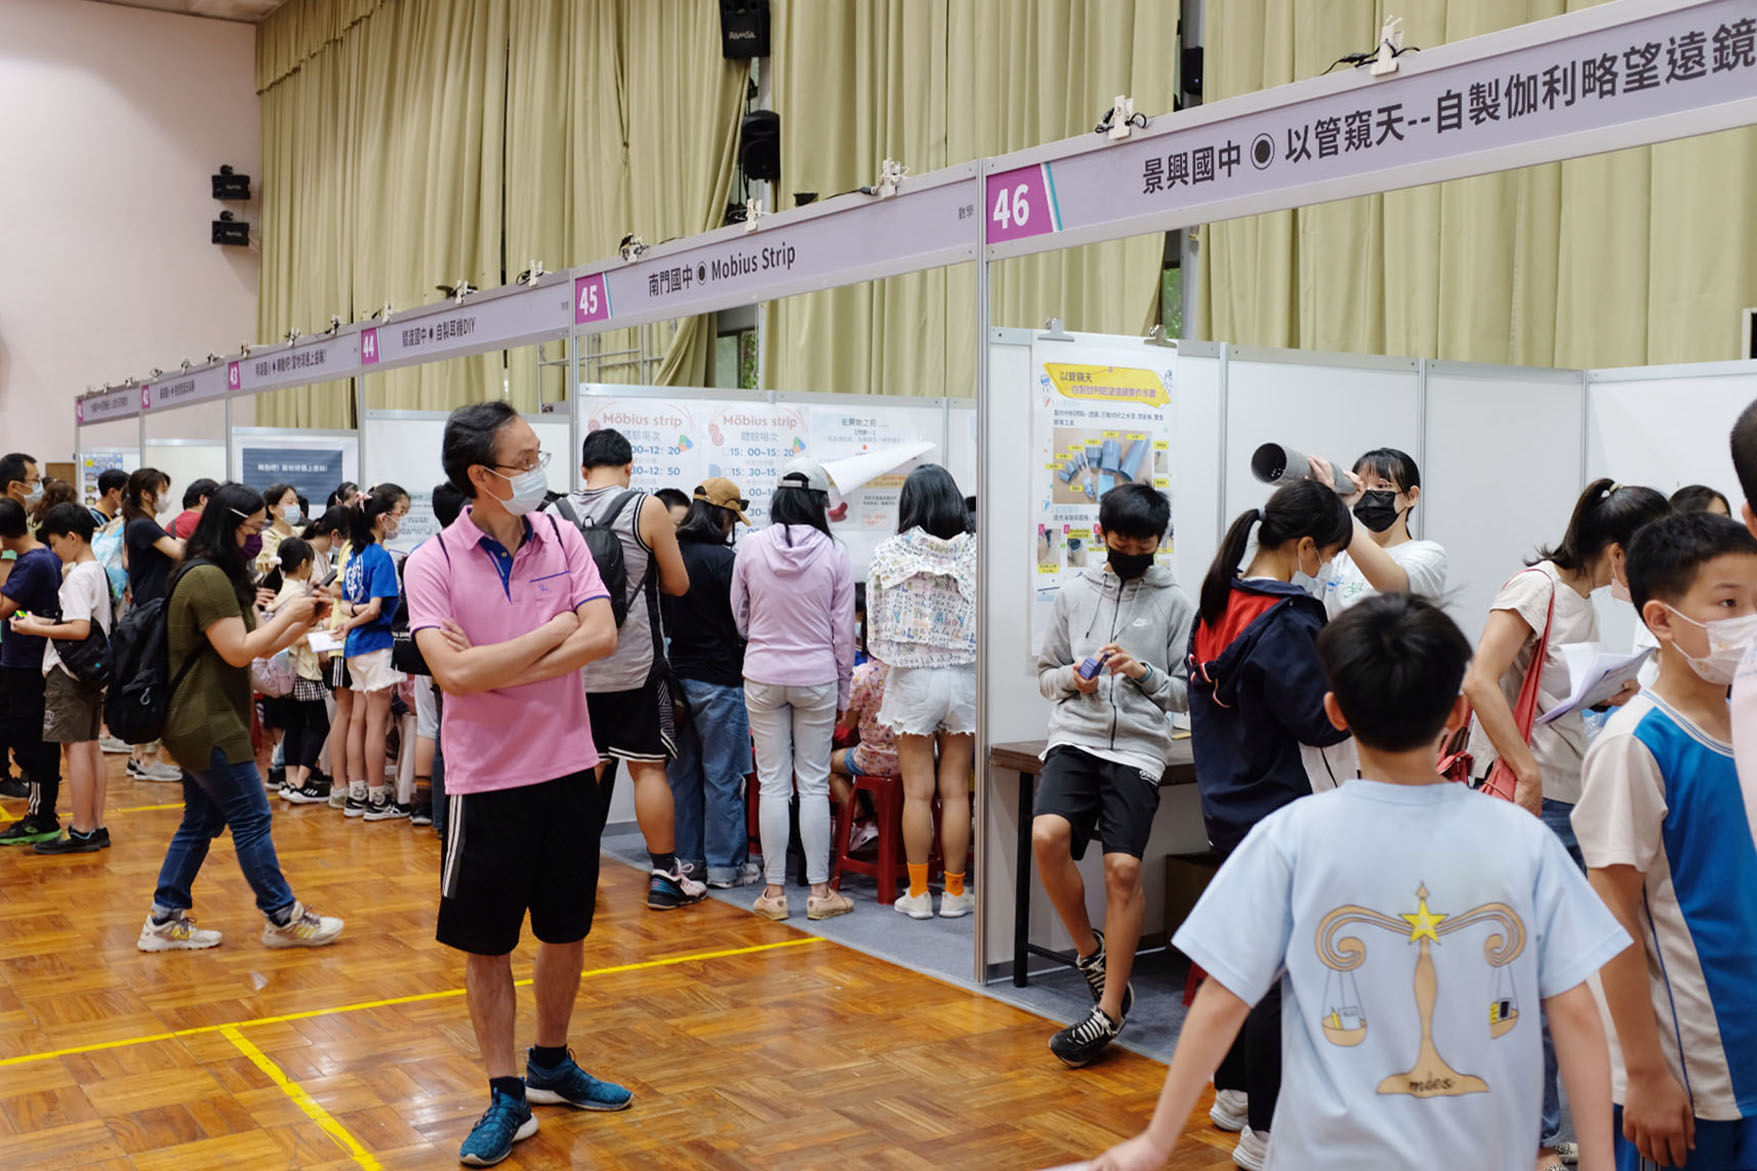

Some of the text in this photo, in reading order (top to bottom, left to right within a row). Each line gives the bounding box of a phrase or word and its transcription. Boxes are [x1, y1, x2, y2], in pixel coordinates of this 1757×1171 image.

[1142, 18, 1757, 195] 景興國中 以管窺天--自製伽利略望遠鏡
[993, 184, 1030, 229] 46
[648, 241, 796, 297] 南門國中 Mobius Strip
[579, 284, 598, 315] 45
[436, 316, 477, 342] 自製耳機DIY
[363, 334, 375, 358] 44
[229, 366, 238, 386] 43
[603, 412, 682, 429] Möbius strip
[723, 415, 797, 430] Möbius strip
[668, 446, 680, 455] 20
[730, 447, 795, 457] 15: 00-15: 20
[668, 467, 680, 476] 50
[732, 467, 745, 476] 15:
